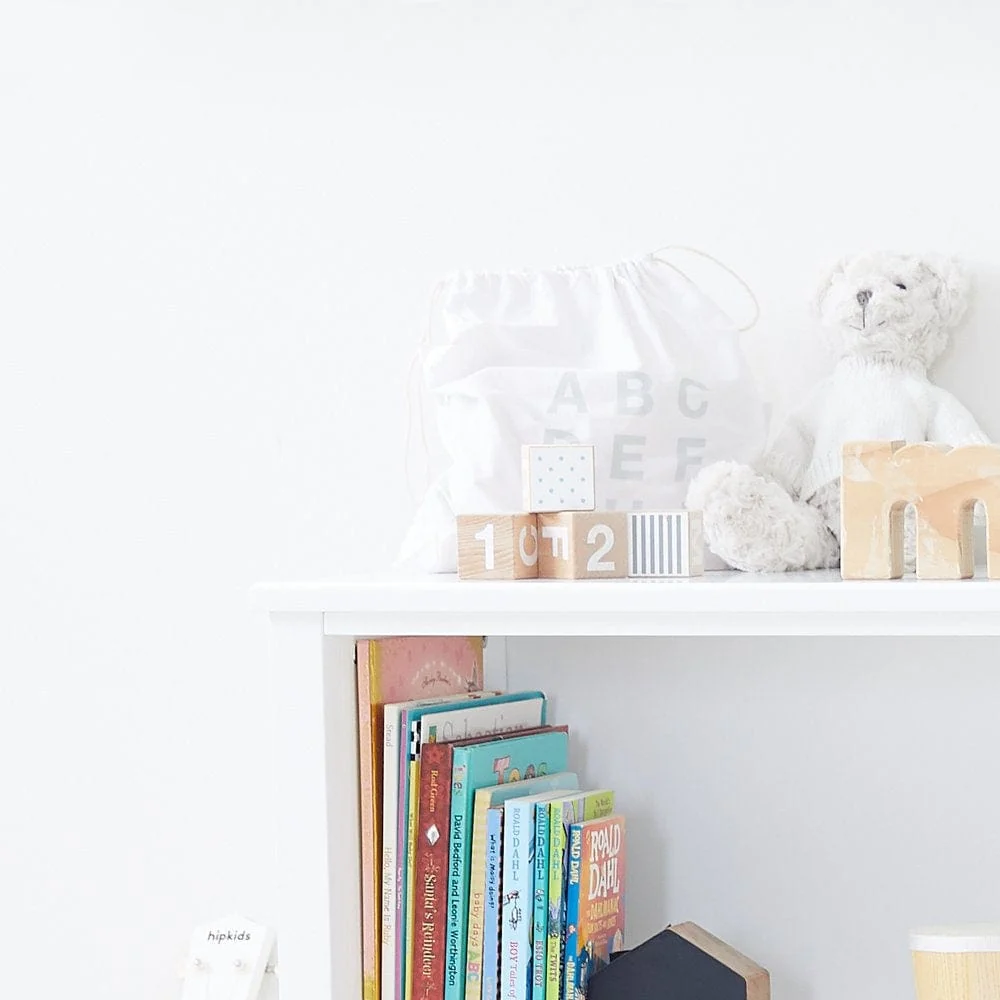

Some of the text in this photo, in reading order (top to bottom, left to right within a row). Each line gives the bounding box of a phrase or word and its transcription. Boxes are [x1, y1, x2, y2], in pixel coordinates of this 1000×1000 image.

[547, 371, 709, 419] A B C
[610, 434, 706, 482] E F
[474, 523, 495, 570] 1
[587, 524, 615, 572] 2
[429, 770, 439, 812] Rod Green
[512, 839, 520, 881] DAHL
[536, 807, 546, 880] ROALD DAHL
[552, 807, 561, 880] ROALD DAHL
[569, 829, 581, 885] ROALD DAHL
[589, 824, 621, 863] ROALD
[448, 815, 463, 986] David Bedford and Leonie Worthington
[588, 857, 620, 901] DAHL
[207, 930, 251, 944] hipkids
[422, 873, 438, 978] Santa's Reindeer
[467, 893, 481, 983] baby days ABC
[510, 941, 519, 963] BOY
[549, 954, 558, 982] TWITS
[507, 989, 516, 999] of
[509, 965, 518, 987] Tales
